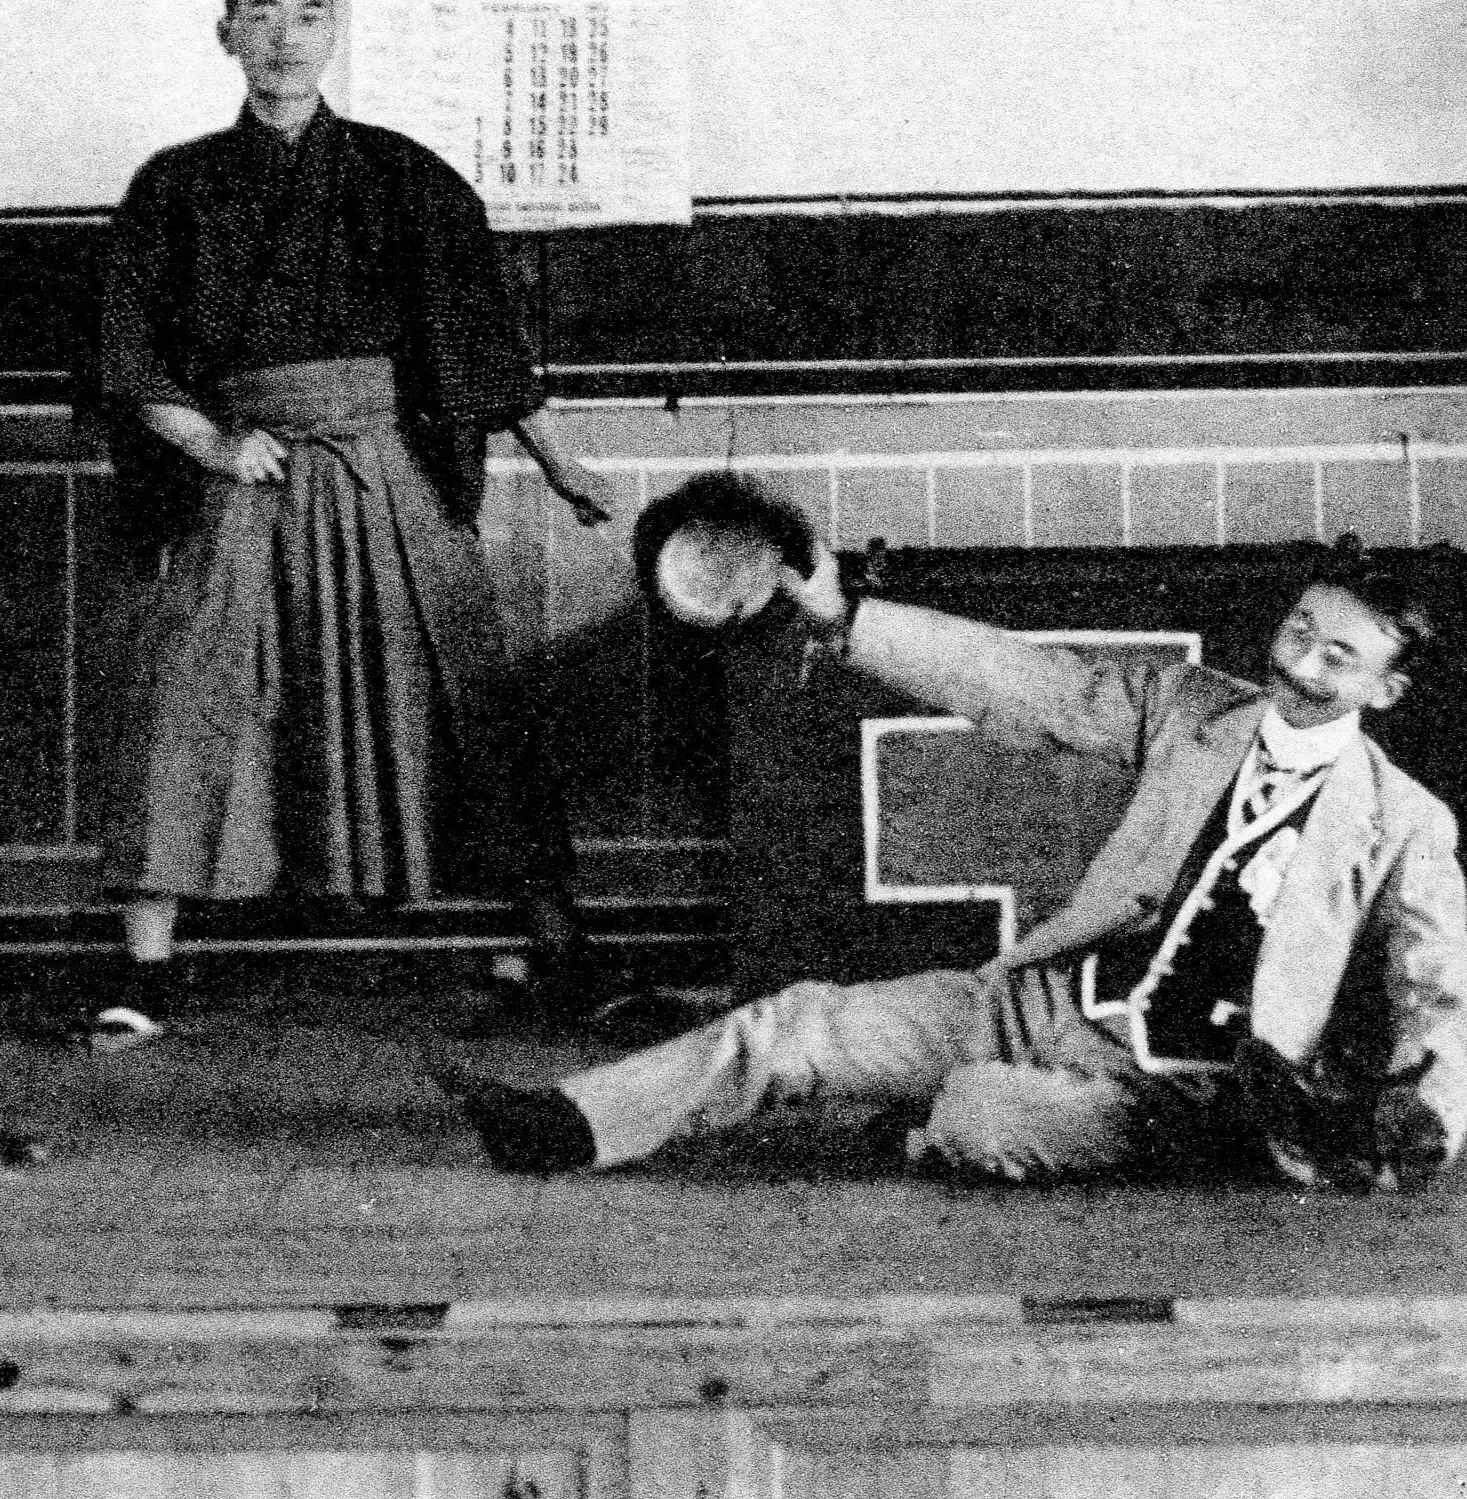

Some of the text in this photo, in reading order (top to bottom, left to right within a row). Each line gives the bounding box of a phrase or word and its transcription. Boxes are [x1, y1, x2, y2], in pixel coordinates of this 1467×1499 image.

[530, 43, 548, 63] 12
[558, 66, 579, 88] 20
[559, 90, 577, 112] 21
[528, 116, 547, 135] 15
